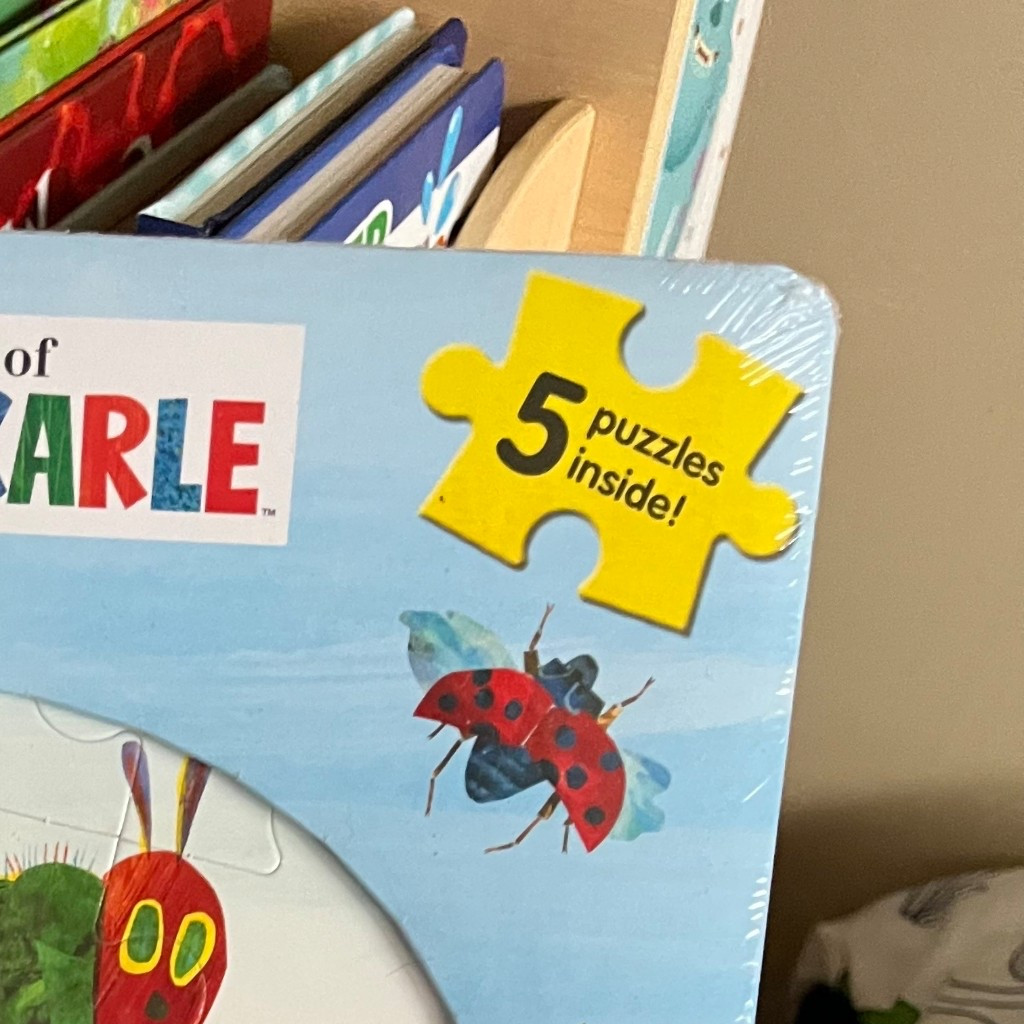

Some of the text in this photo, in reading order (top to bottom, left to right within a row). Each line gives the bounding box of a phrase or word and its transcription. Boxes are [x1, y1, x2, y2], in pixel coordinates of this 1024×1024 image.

[4, 337, 59, 377] of
[496, 371, 725, 487] 5 puzzles
[567, 446, 687, 527] inside!
